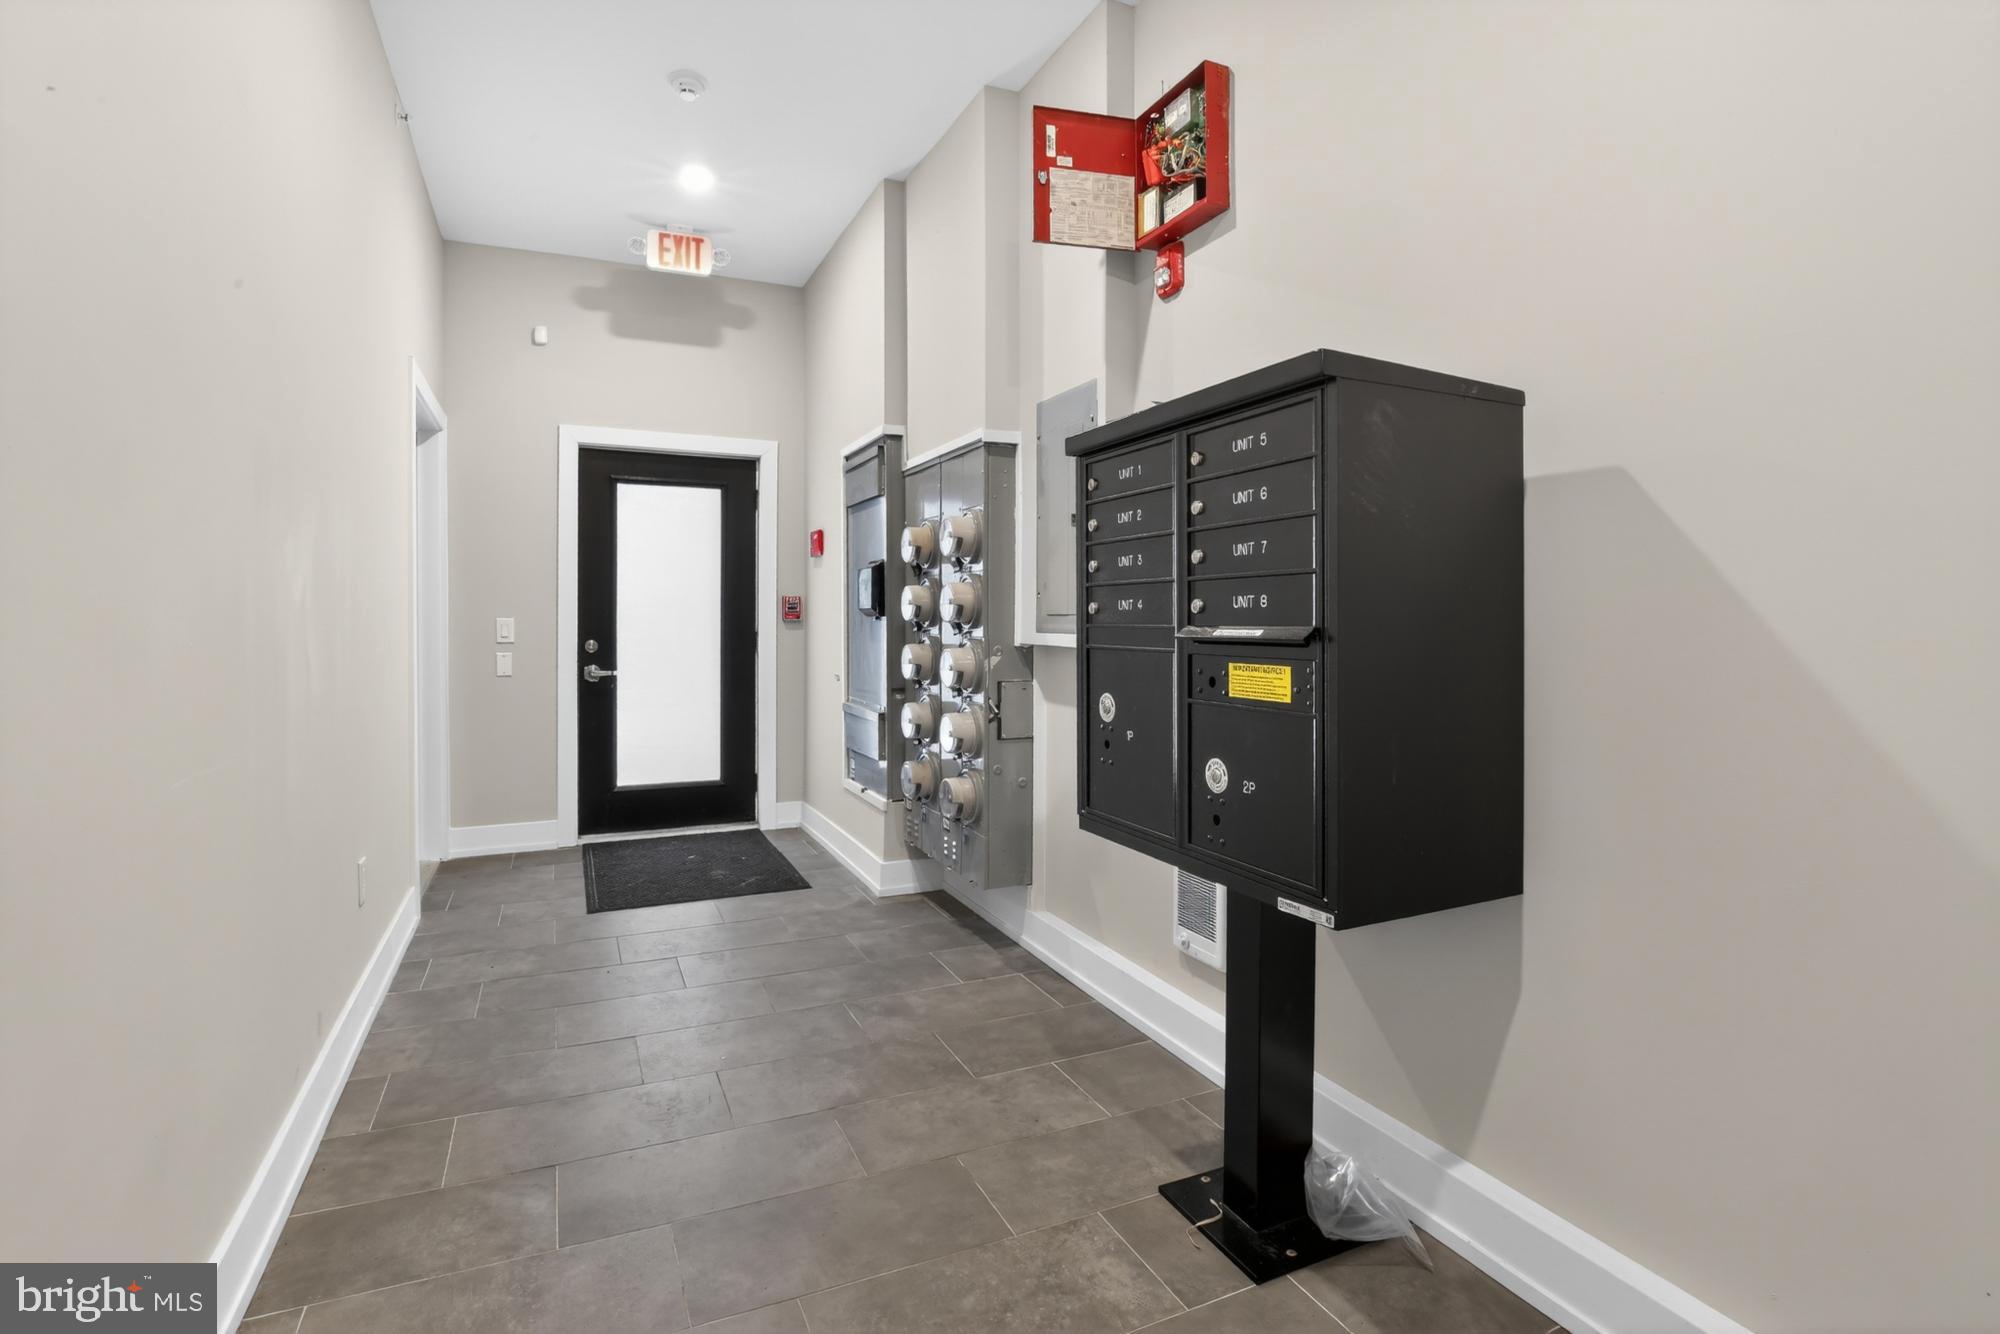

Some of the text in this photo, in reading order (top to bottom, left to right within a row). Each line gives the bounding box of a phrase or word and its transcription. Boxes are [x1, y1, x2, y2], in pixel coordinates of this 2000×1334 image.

[658, 231, 704, 271] EXIT
[1232, 432, 1267, 452] UNIT 5
[1118, 464, 1142, 480] UNIT 1
[1232, 486, 1268, 504] UNIT 6
[1117, 509, 1142, 524] UNIT 2
[1232, 540, 1267, 557] UNIT 7
[1117, 554, 1142, 567] UNIT 3
[1117, 599, 1143, 611] UNIT 4
[1232, 594, 1267, 609] UNIT 8
[1242, 780, 1256, 794] 2P
